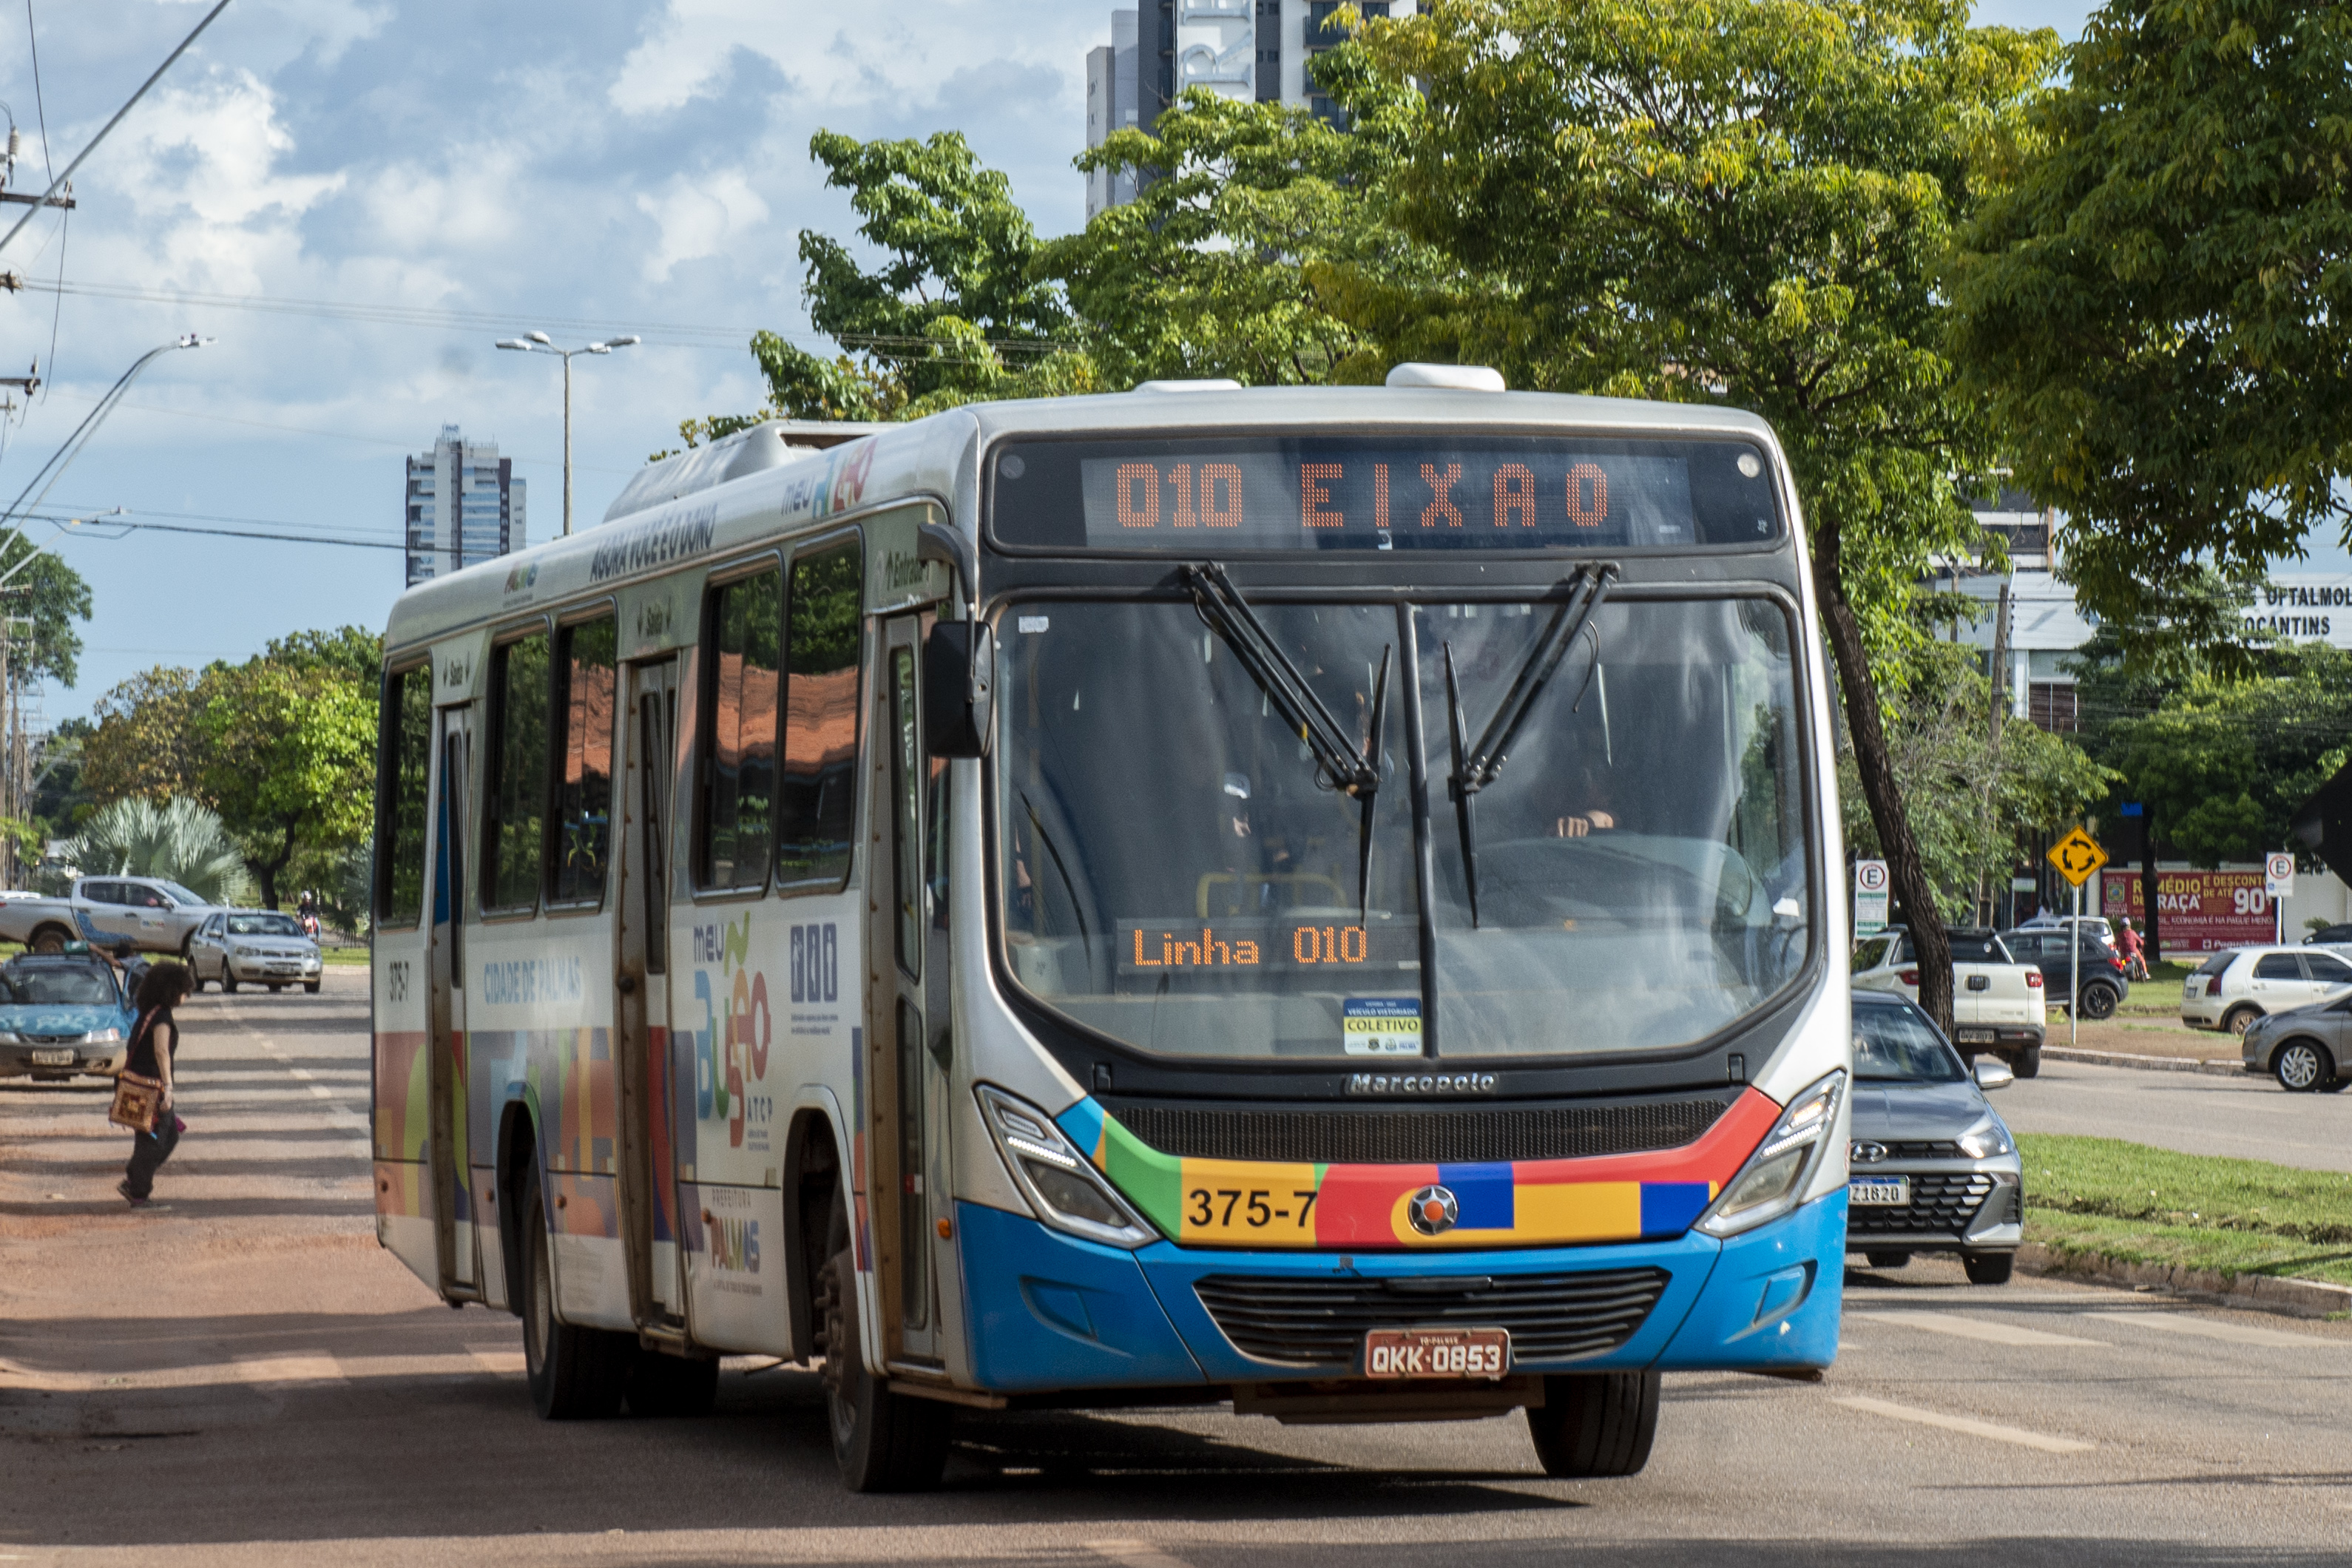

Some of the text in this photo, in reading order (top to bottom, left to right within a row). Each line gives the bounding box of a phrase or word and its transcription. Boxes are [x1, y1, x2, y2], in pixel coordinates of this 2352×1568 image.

[1117, 463, 1243, 528] 010
[2244, 616, 2331, 635] OCANTINS
[1867, 869, 1878, 885] E
[1135, 926, 1368, 966] Linha 010
[389, 961, 410, 1003] 375-7
[483, 955, 581, 1006] CIDADE DE PALMAS
[1348, 1019, 1419, 1032] COLETIVO
[1350, 1072, 1495, 1095] Marcopolo
[747, 1096, 773, 1123] ATCP
[1188, 1187, 1319, 1229] 375-7
